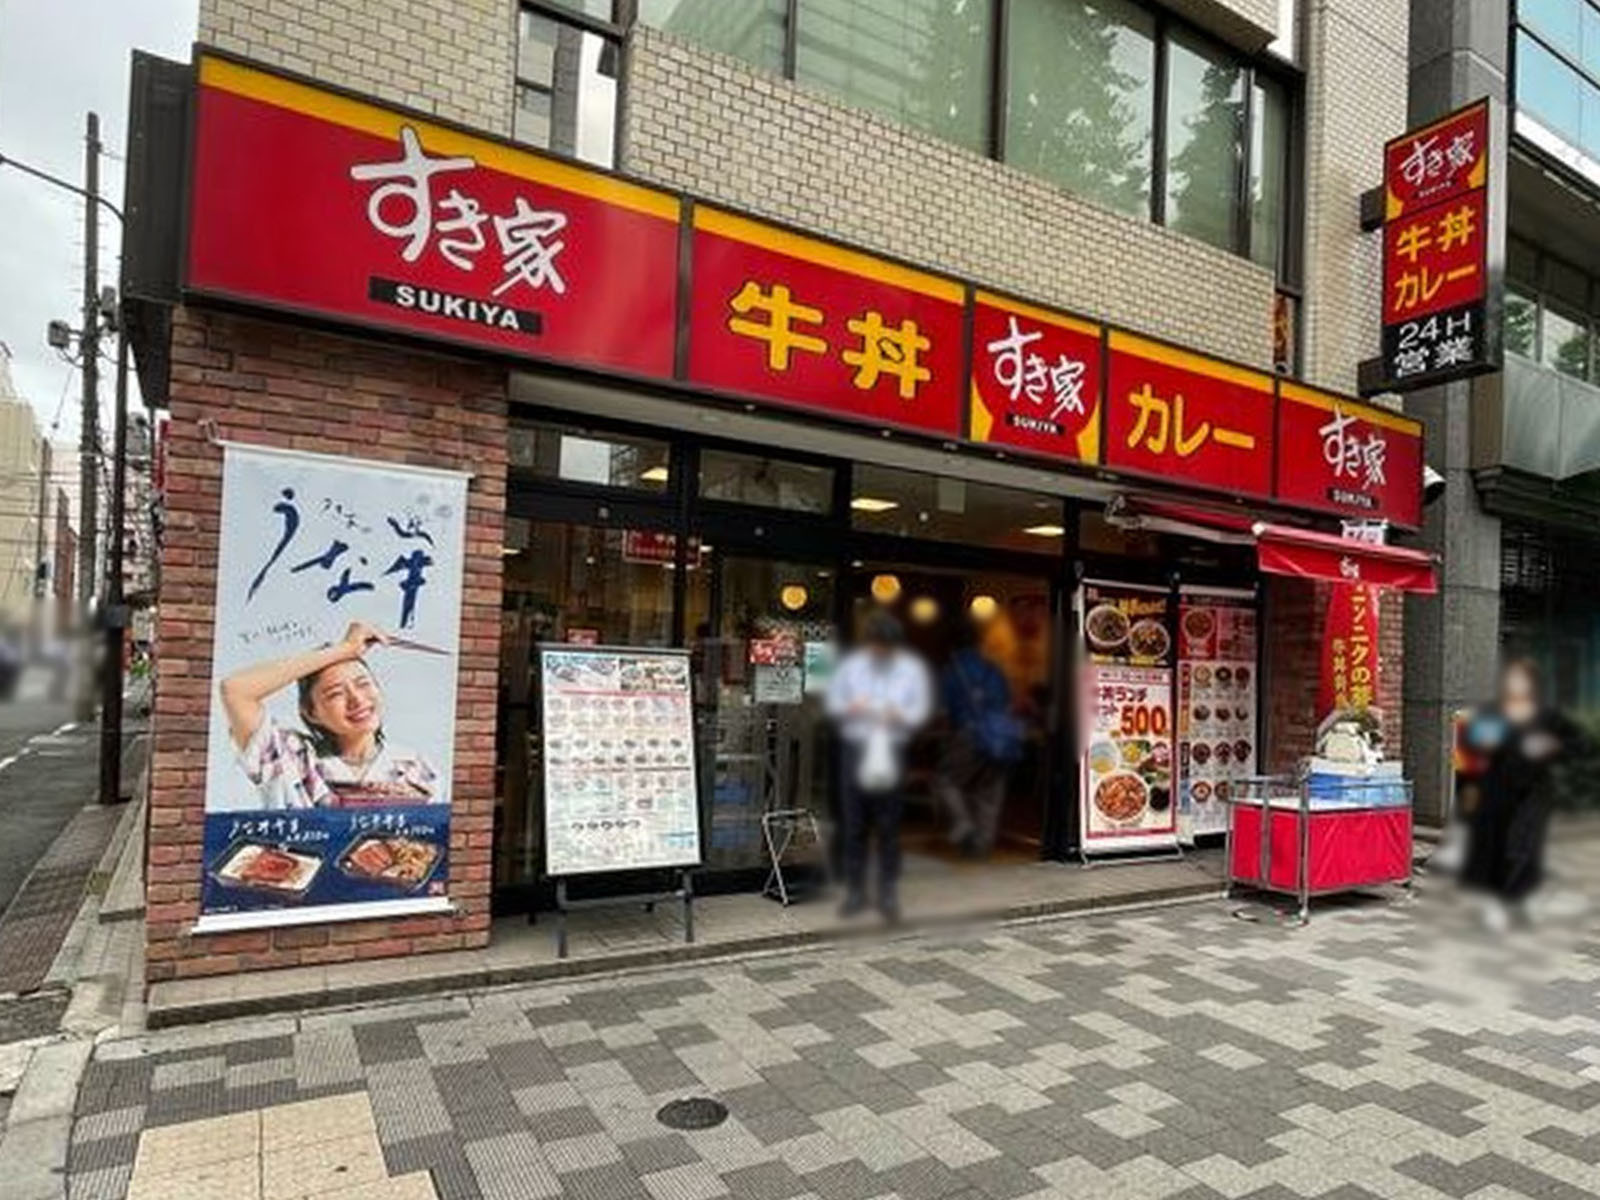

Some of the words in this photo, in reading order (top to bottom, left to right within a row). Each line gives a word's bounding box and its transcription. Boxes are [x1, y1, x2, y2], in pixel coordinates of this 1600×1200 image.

[1399, 130, 1475, 186] すき家
[351, 126, 566, 297] すき家
[1396, 205, 1475, 262] 牛丼
[395, 285, 520, 331] SUKIYA
[1394, 264, 1477, 312] カレー
[729, 280, 932, 399] 牛丼
[1394, 337, 1474, 378] 営業
[1400, 311, 1471, 349] 24H
[987, 315, 1086, 420] すき家
[1128, 383, 1255, 455] カレー
[1319, 402, 1387, 491] すき家
[1121, 704, 1167, 737] 500
